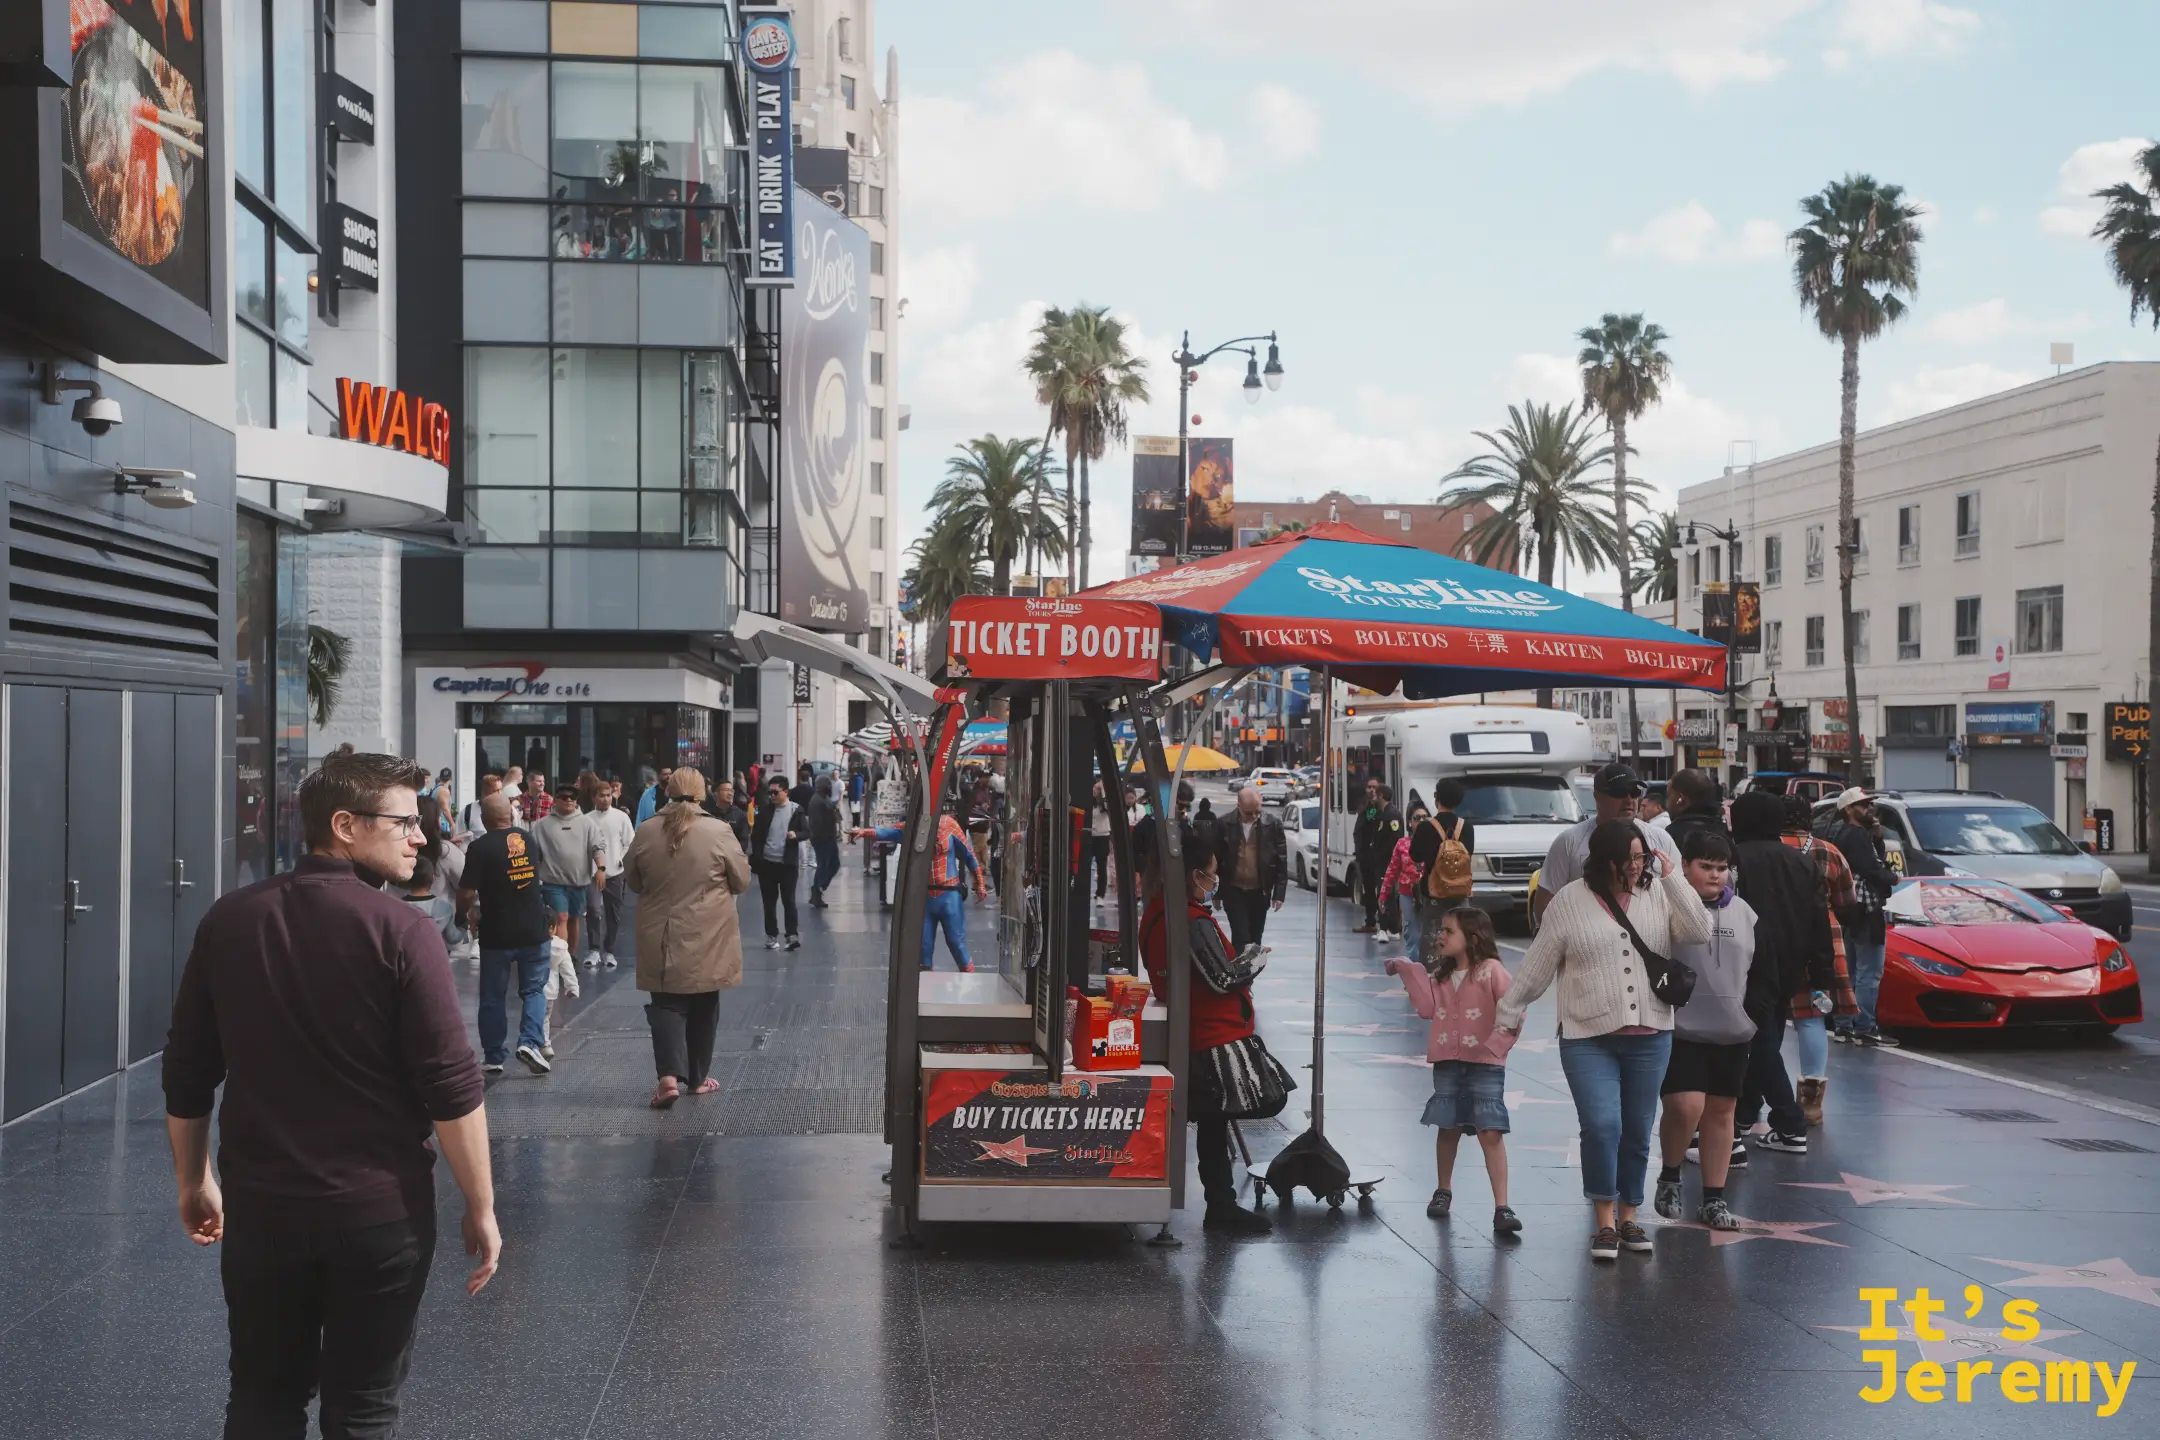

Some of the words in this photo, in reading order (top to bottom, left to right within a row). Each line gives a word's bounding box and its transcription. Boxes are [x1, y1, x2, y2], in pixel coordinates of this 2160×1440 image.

[750, 30, 777, 47] DAVE
[776, 28, 785, 41] &
[757, 81, 782, 129] PLAY
[758, 154, 783, 214] DRINK
[343, 217, 377, 249] SHOPS
[343, 246, 378, 279] DINING
[760, 238, 783, 272] EAT
[802, 221, 858, 318] Wonka
[1330, 592, 1442, 611] TOURS
[950, 620, 1050, 656] TICKET
[1060, 624, 1160, 660] BOOTH
[1240, 628, 1333, 647] TICKETS
[1354, 629, 1449, 648] BOLETOS
[1524, 639, 1604, 661] KARTEN
[1624, 648, 1715, 676] BIGLIETTI
[555, 682, 590, 696] café
[2101, 819, 2109, 850] TOURS
[509, 871, 534, 881] TROJANS
[511, 857, 529, 867] USC
[1108, 1044, 1139, 1052] TICKETS
[952, 1106, 998, 1129] BUY
[1000, 1106, 1079, 1130] TICKETS
[1083, 1107, 1146, 1131] HERE!
